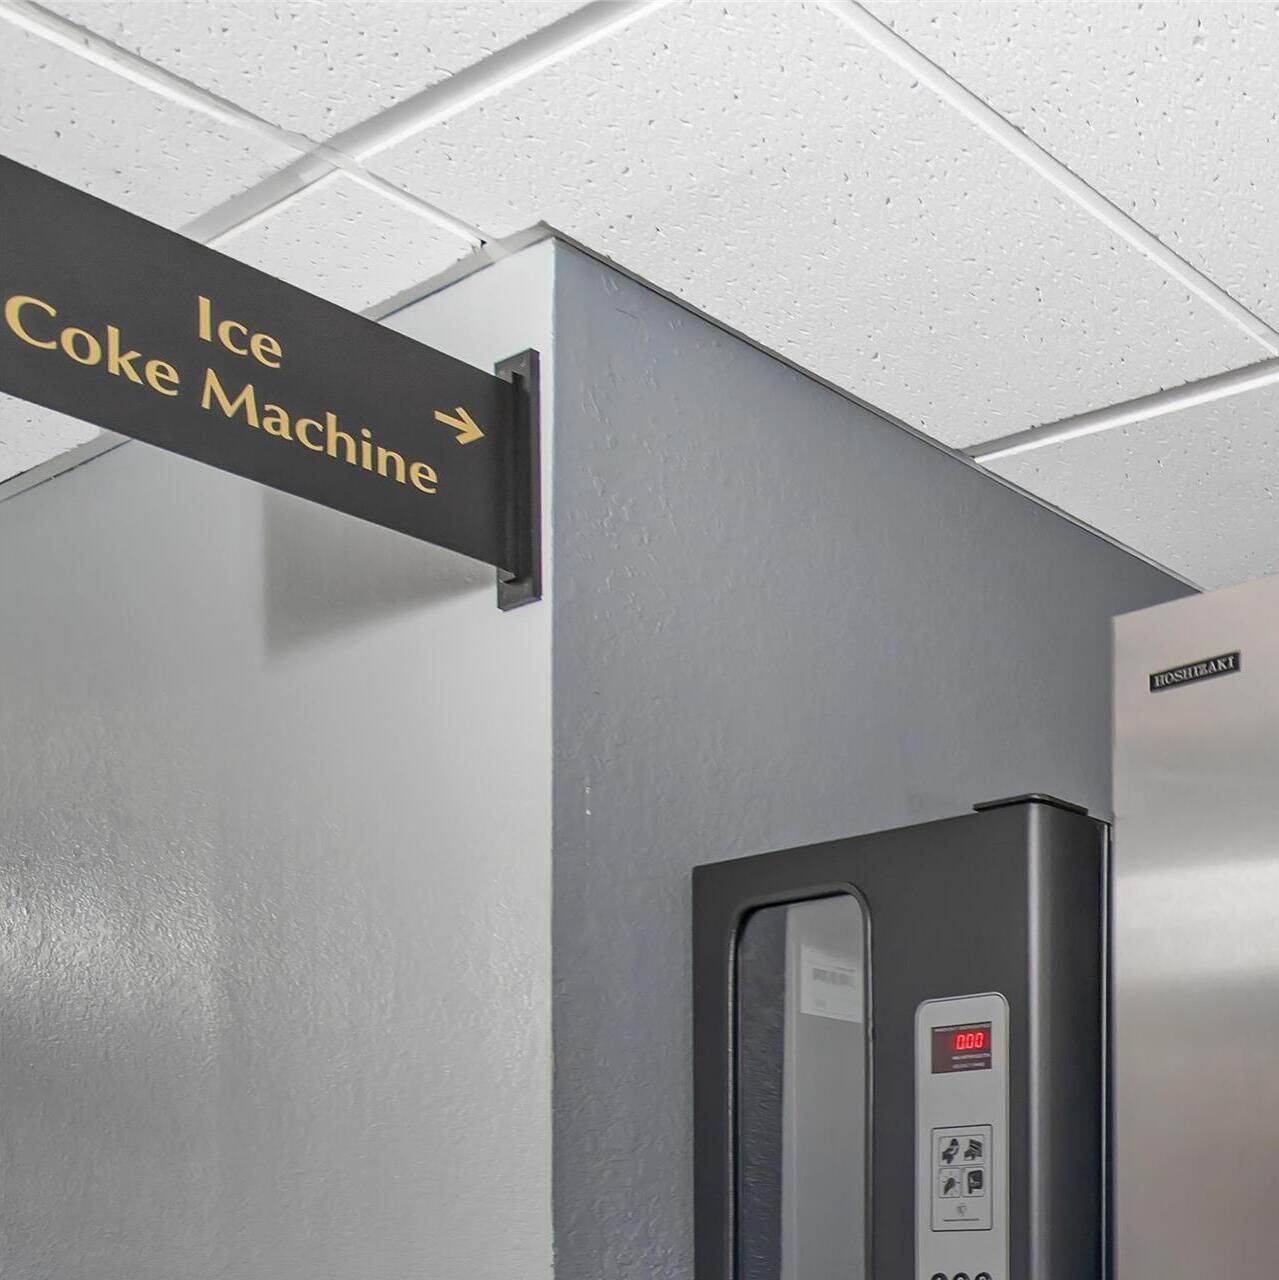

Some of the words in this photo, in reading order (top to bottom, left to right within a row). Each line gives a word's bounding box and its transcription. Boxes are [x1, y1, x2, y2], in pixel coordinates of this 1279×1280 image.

[4, 295, 180, 397] Coke
[200, 368, 439, 495] Machine
[197, 295, 284, 369] Ice
